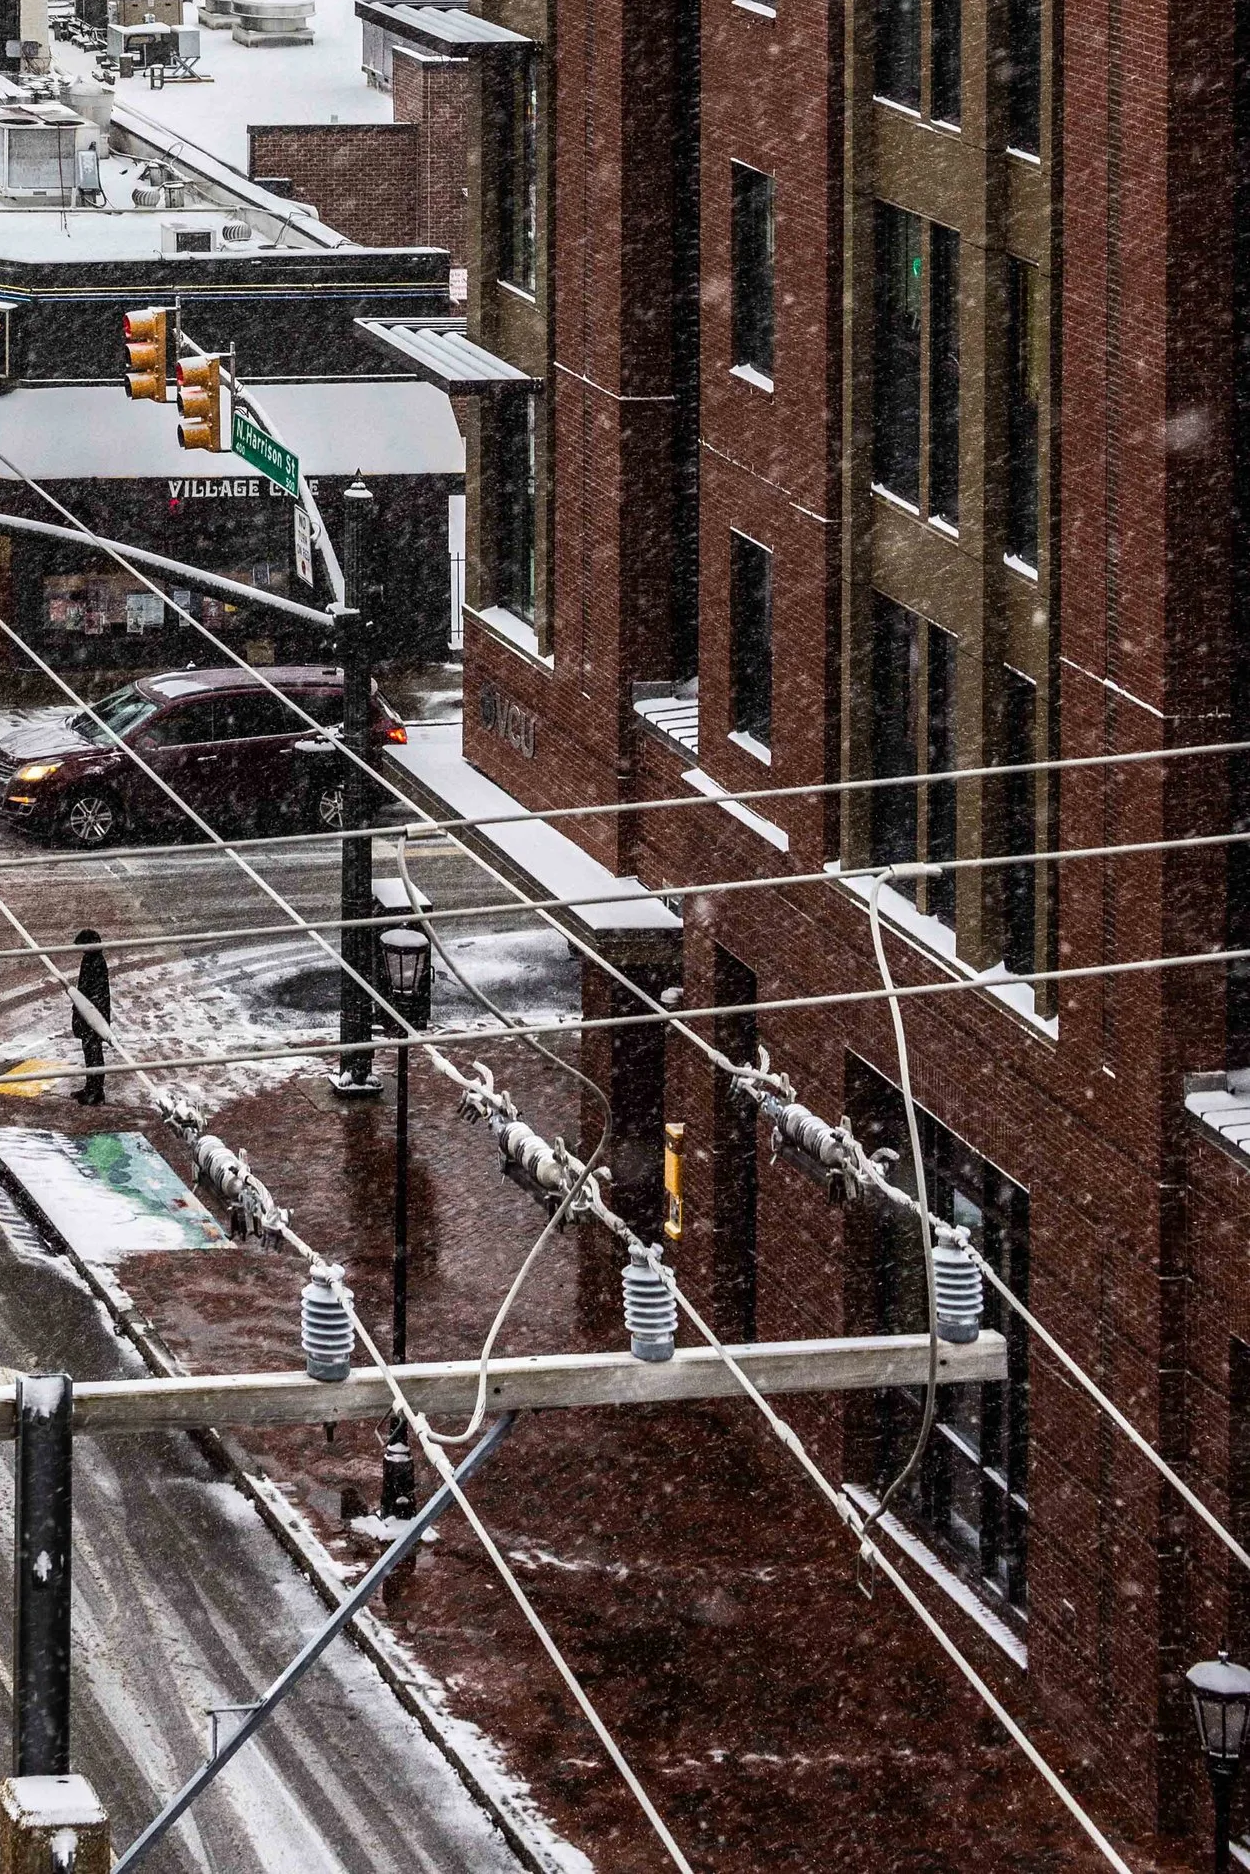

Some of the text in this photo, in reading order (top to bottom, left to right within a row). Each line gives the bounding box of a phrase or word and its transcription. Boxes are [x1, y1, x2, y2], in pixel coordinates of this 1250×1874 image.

[246, 424, 283, 469] Harrison
[285, 453, 296, 479] St
[167, 479, 260, 498] VILLAGE
[495, 691, 538, 759] VCU
